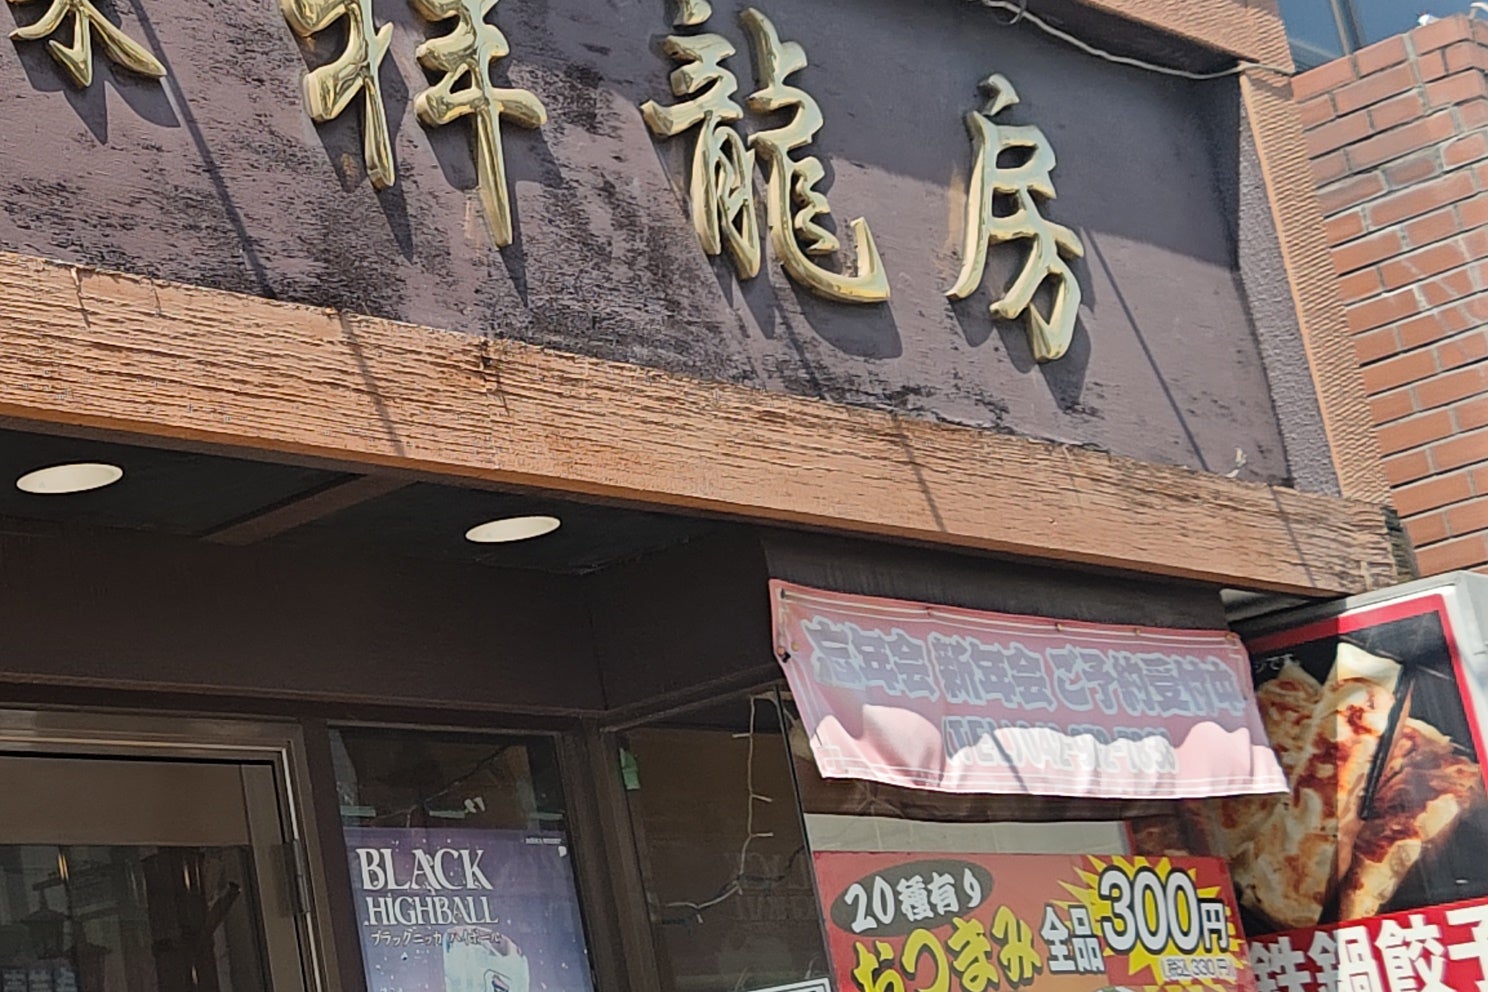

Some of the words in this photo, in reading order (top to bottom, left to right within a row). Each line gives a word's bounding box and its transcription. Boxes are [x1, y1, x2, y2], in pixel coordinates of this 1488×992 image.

[928, 632, 1058, 711] 新年会
[355, 848, 494, 891] BLACK
[844, 867, 982, 934] 20種有り
[366, 893, 499, 926] HIGHBALL
[852, 904, 1043, 992] おつまみ
[1040, 903, 1107, 974] 全品
[1097, 866, 1229, 956] 300円
